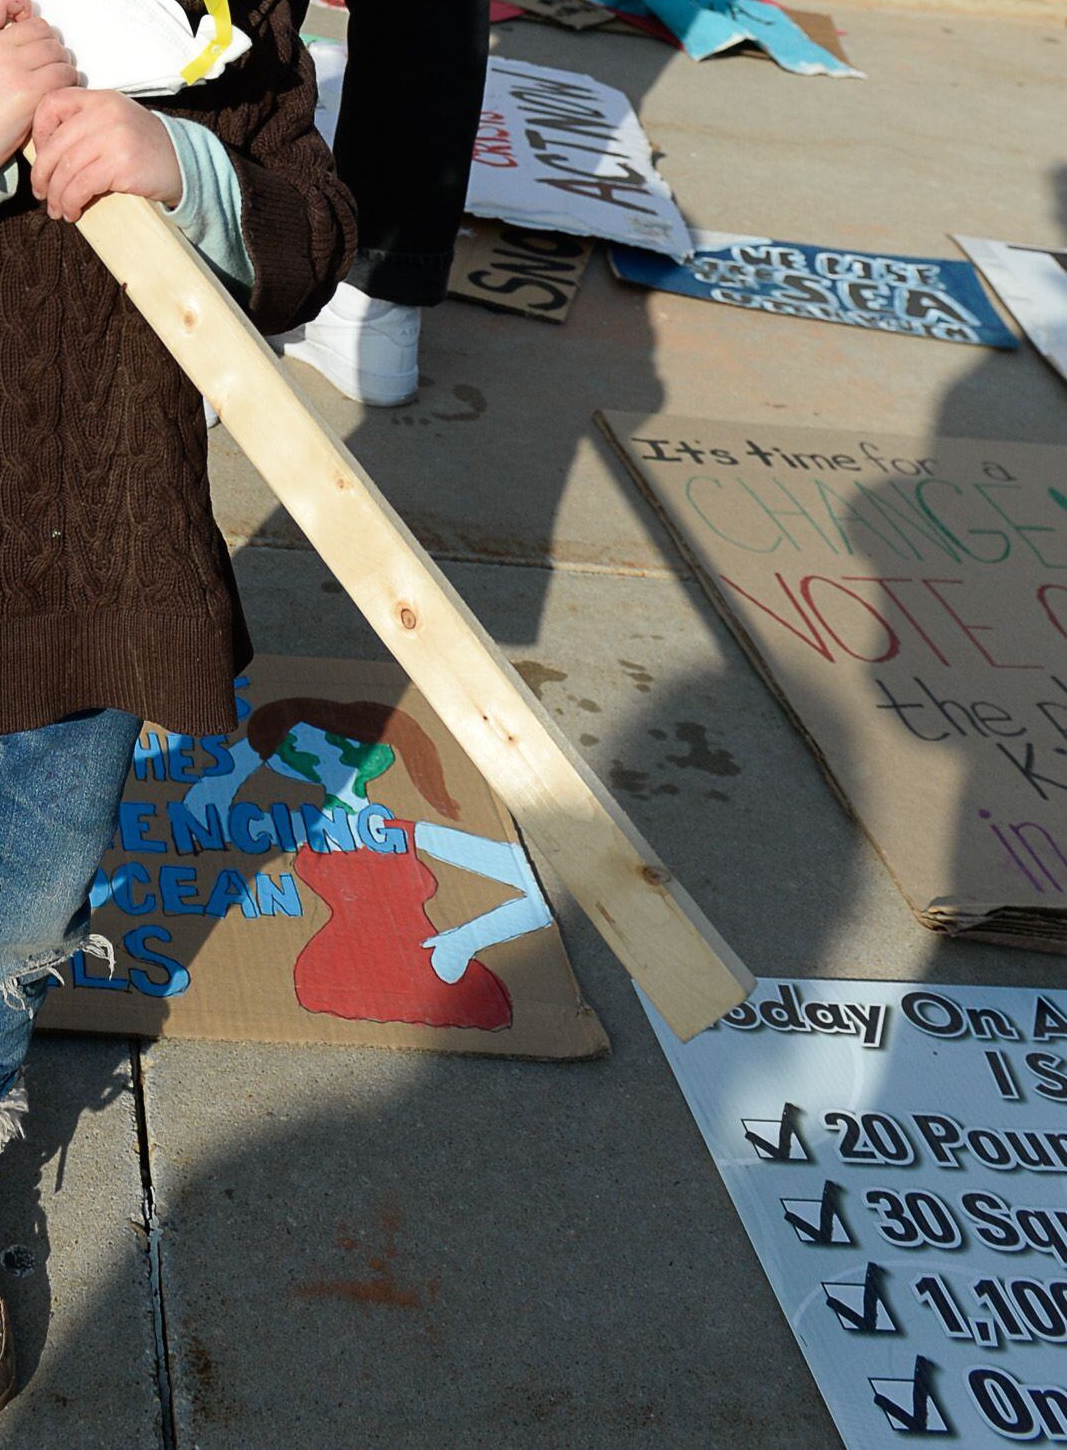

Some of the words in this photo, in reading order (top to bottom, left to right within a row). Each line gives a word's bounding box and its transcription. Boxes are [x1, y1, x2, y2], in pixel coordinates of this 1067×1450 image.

[524, 129, 659, 216] ACT
[746, 440, 861, 472] time
[859, 441, 937, 477] for
[982, 460, 1017, 481] a
[685, 474, 1067, 569] CHANGE
[721, 572, 1046, 670] VOTE
[875, 676, 1027, 742] the
[901, 991, 1019, 1040] On
[984, 1049, 1020, 1100] I
[823, 1110, 916, 1166] 20
[865, 1187, 963, 1250] 30
